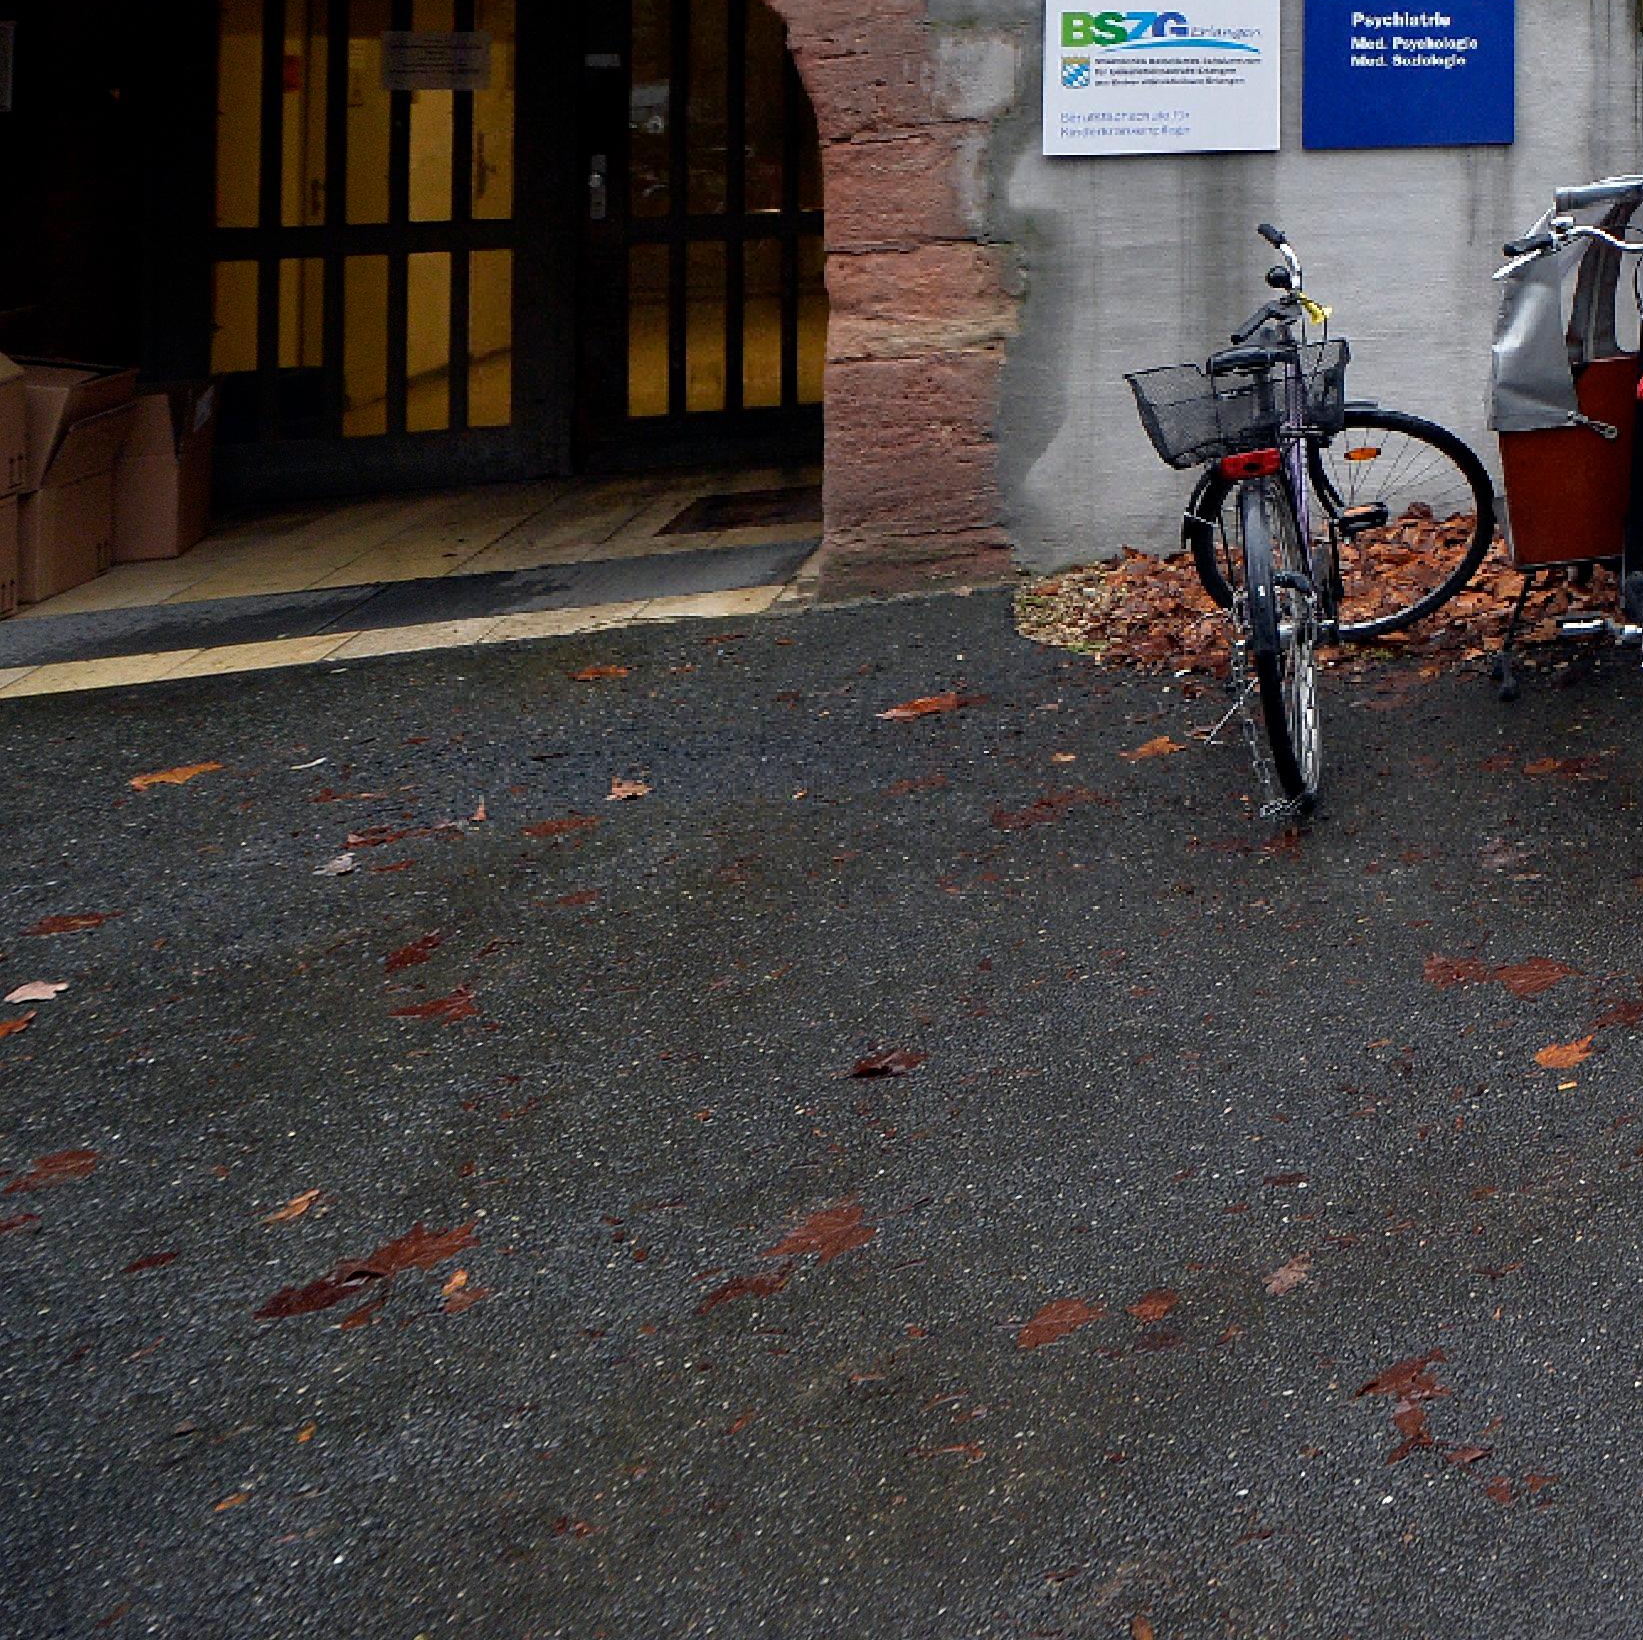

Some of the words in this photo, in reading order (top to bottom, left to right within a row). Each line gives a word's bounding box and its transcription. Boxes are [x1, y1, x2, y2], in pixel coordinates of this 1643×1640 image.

[1351, 11, 1451, 29] Psychiatrie
[1061, 11, 1190, 48] BSZG
[1350, 36, 1389, 50] Med.
[1392, 36, 1478, 53] Psychologie
[1350, 53, 1389, 67] Med.
[1392, 53, 1468, 70] Soziologie
